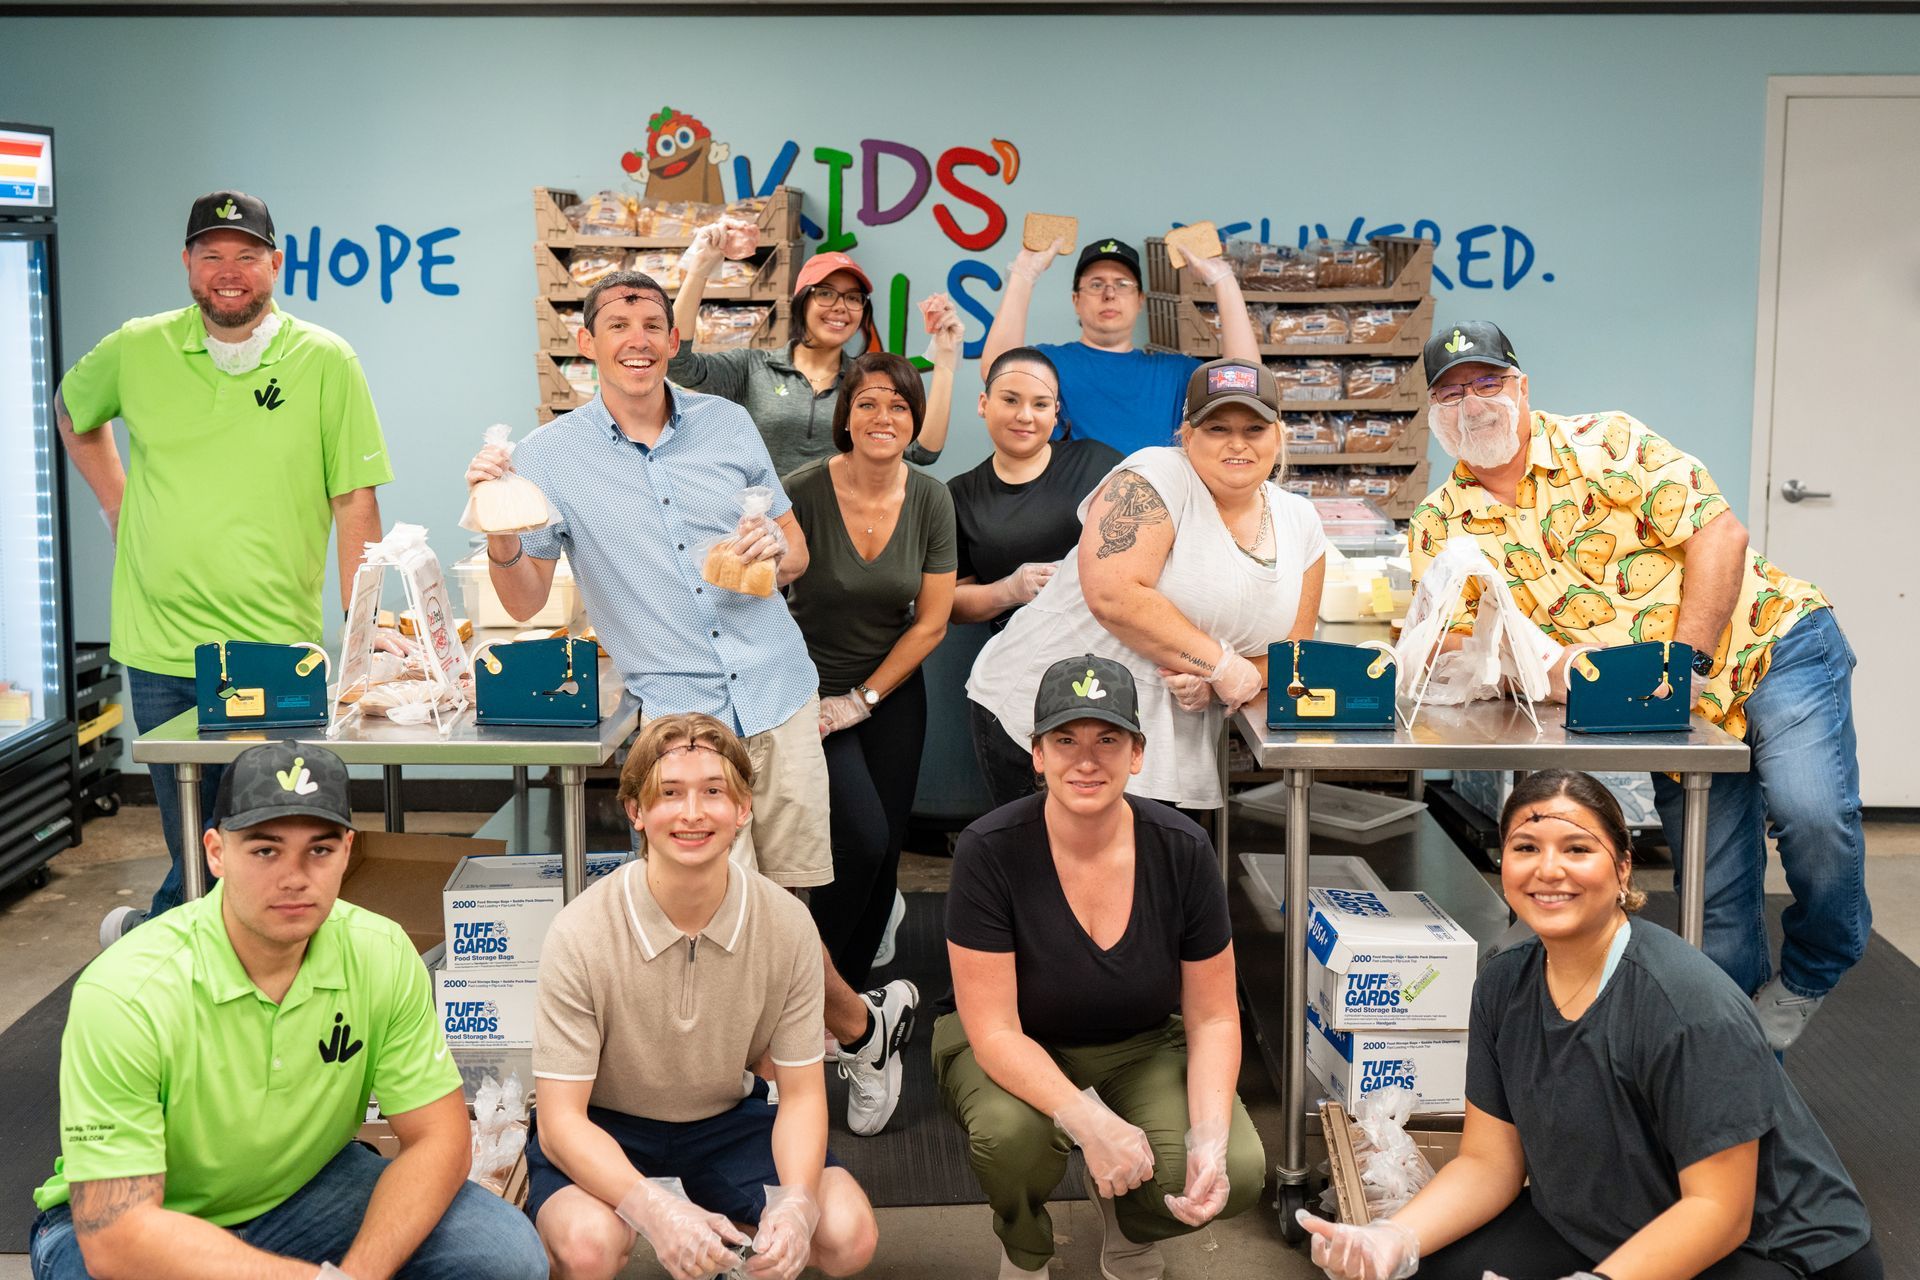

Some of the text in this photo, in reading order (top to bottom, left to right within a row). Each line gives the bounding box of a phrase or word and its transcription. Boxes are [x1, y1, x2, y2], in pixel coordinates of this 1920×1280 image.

[284, 224, 460, 303] HOPE
[454, 922, 494, 938] TUFF
[1312, 921, 1326, 945] USA
[453, 937, 507, 954] GARDS
[1347, 974, 1388, 990] TUFF
[1345, 990, 1400, 1006] GARDS
[445, 1002, 484, 1017] TUFF
[445, 1017, 498, 1032] GARDS
[1363, 1060, 1403, 1076] TUFF
